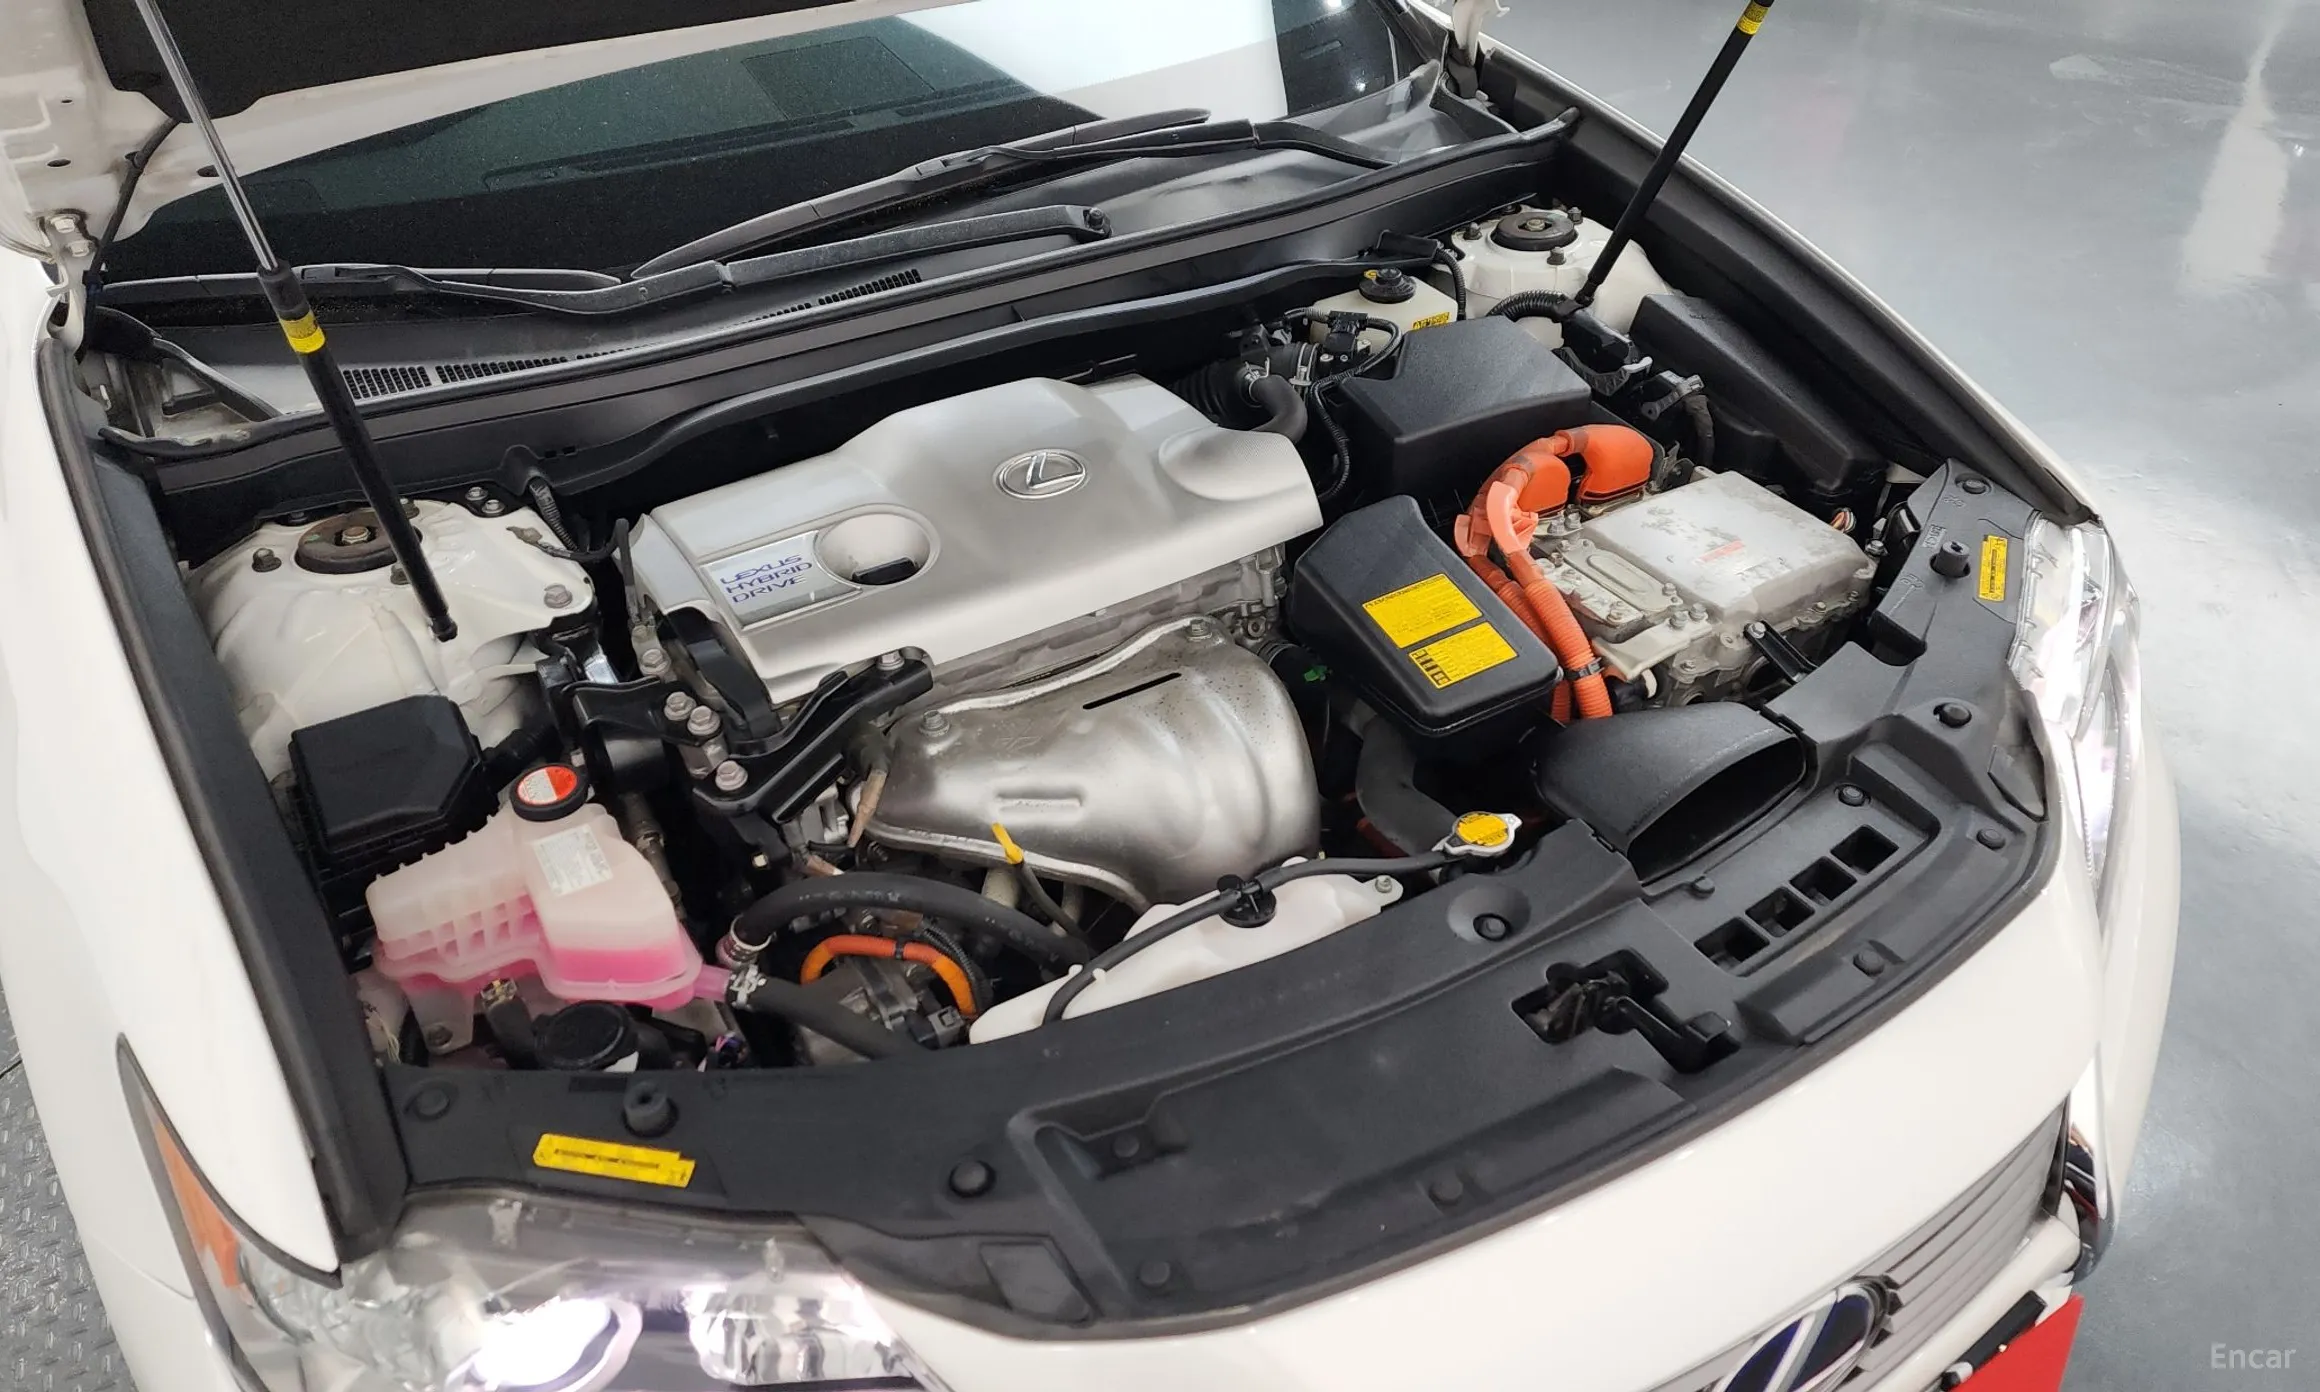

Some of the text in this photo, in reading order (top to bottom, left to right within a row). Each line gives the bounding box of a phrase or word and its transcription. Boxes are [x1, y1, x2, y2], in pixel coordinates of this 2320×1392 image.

[720, 554, 802, 584] LEXUS
[726, 562, 812, 593] HYBRID
[732, 574, 806, 602] DRIVE
